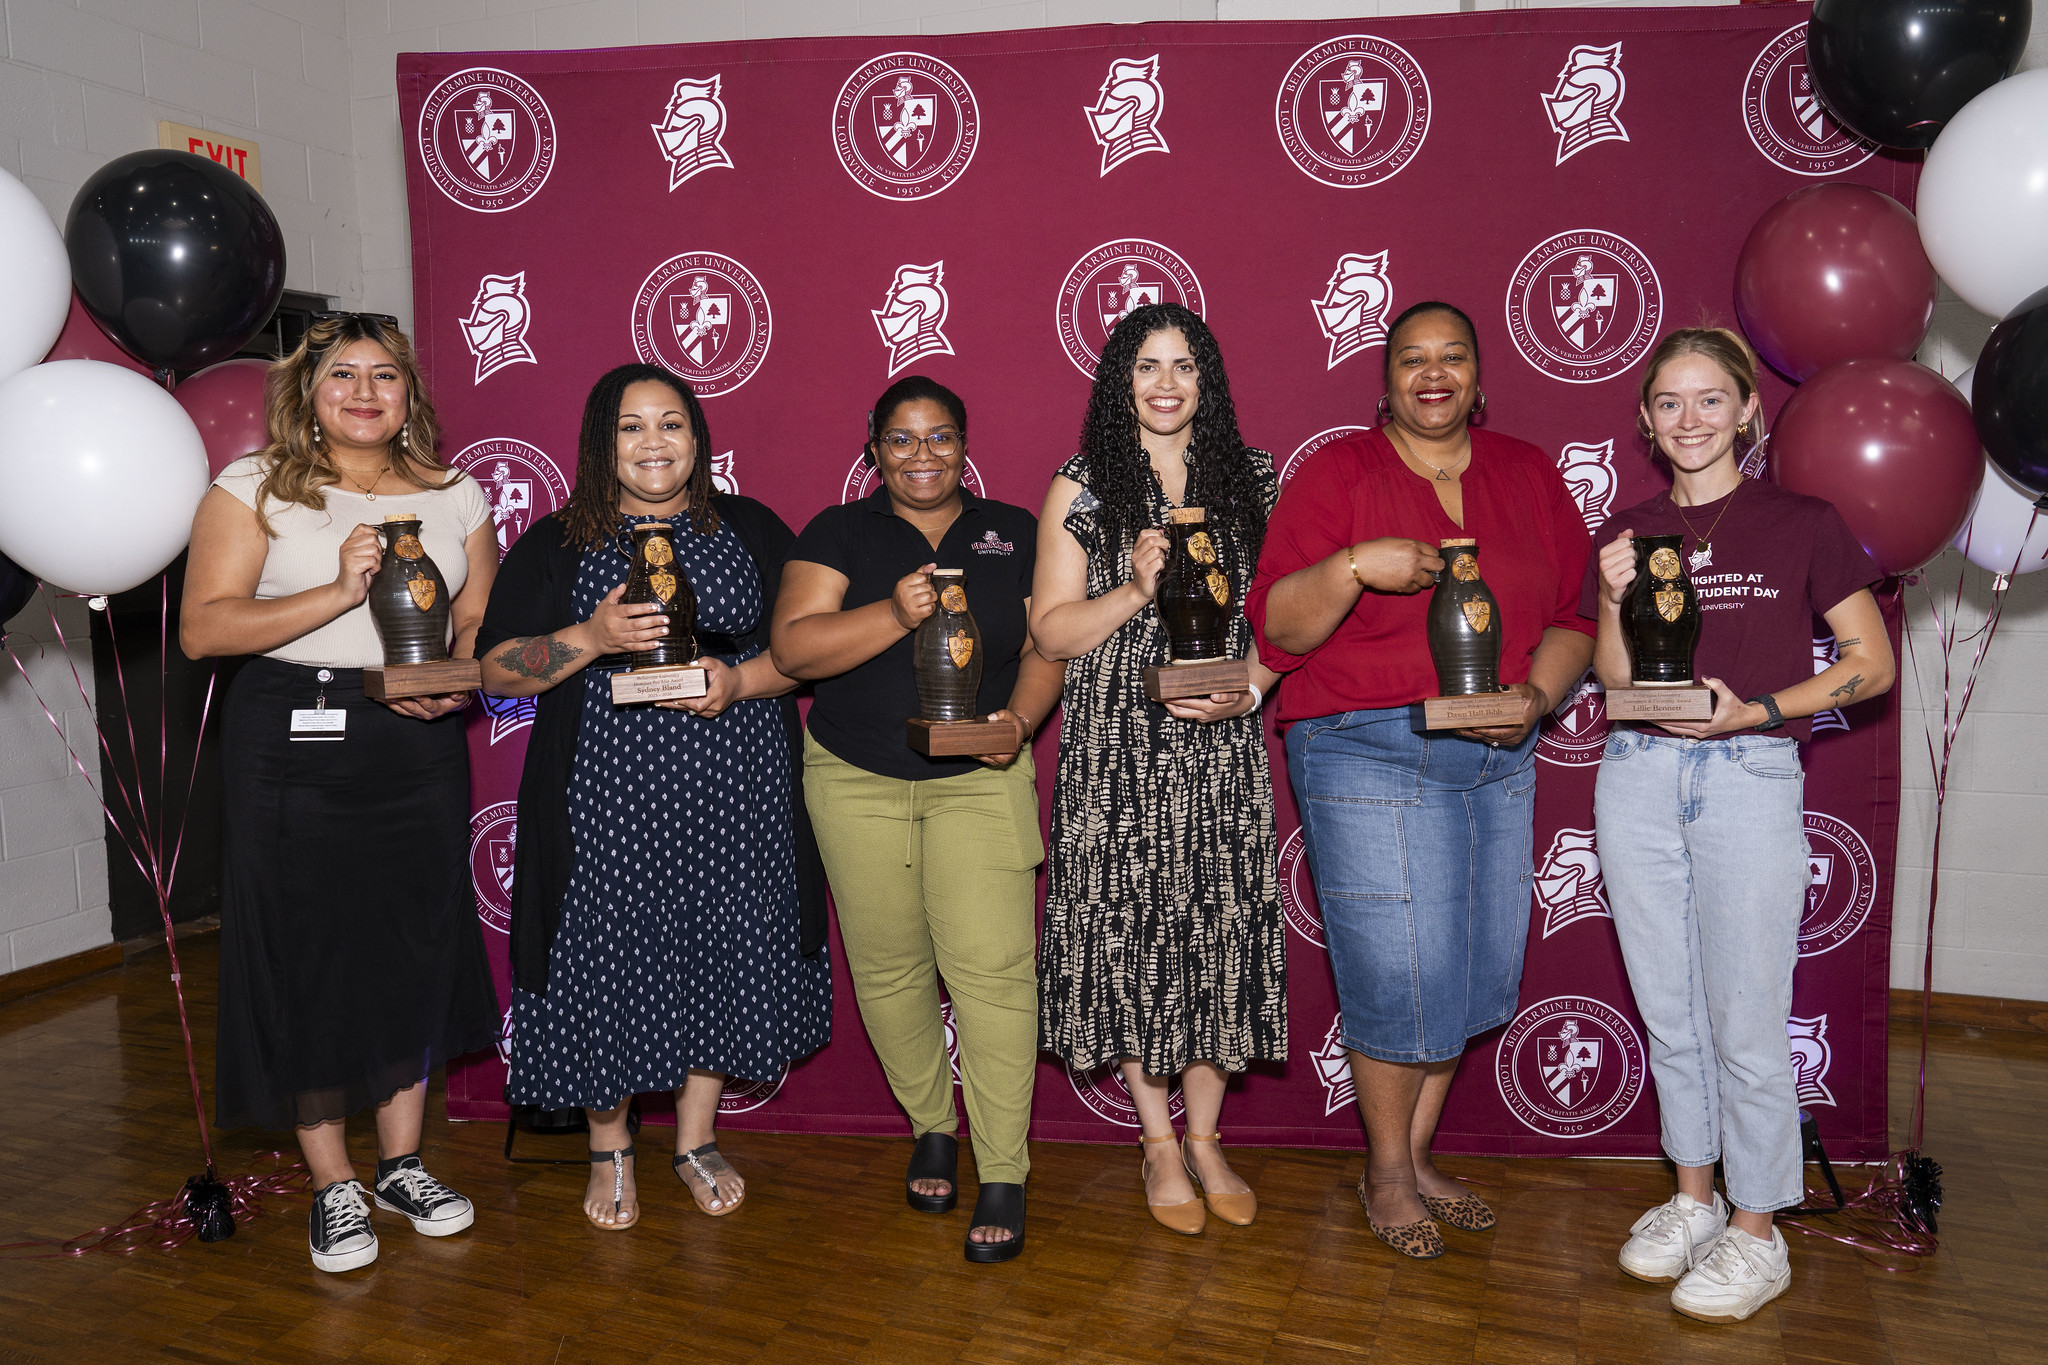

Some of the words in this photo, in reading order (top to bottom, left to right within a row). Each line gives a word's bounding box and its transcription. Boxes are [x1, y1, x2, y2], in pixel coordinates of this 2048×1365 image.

[1287, 41, 1355, 92] BELLARMINE
[1360, 41, 1422, 88] UNIVERSITY
[1755, 30, 1806, 78] BELLARM
[426, 73, 483, 120] BELLARMINE
[487, 74, 546, 119] UNIVERSITY
[841, 58, 904, 108] BELLARMINE
[909, 58, 970, 104] UNIVERSITY
[1281, 110, 1320, 173] LOUISVILLE
[1342, 174, 1366, 183] 1950
[1388, 106, 1425, 168] KENTUCKY
[1329, 155, 1361, 164] VERITATIS
[1363, 150, 1384, 162] AMORE
[1748, 97, 1786, 161] LOUISVILLE
[1809, 161, 1835, 170] 1950
[1798, 142, 1830, 151] VERITATIS
[423, 137, 462, 198] LOUISVILLE
[481, 199, 503, 208] 1950
[522, 136, 551, 194] KENTUCKY
[837, 126, 876, 186] LOUISVILLE
[897, 187, 920, 196] 1950
[941, 121, 974, 181] KENTUCKY
[885, 169, 915, 177] VERITATIS
[917, 163, 936, 176] AMORE
[462, 176, 468, 184] IN
[469, 181, 497, 190] VERITATIS
[500, 176, 517, 189] AMORE
[640, 257, 700, 306] BELLARMINE
[704, 258, 762, 304] UNIVERSITY
[1066, 245, 1130, 295] BELLARMINE
[1136, 245, 1196, 293] UNIVERSITY
[1516, 235, 1585, 287] BELLARMINE
[1591, 236, 1653, 285] UNIVERSITY
[636, 324, 656, 366] LOUISV
[694, 384, 715, 393] 1950
[735, 321, 767, 379] KENTUCKY
[1511, 305, 1550, 368] LOUISVILLE
[1572, 369, 1597, 378] 1950
[1620, 303, 1657, 364] KENTUCKY
[1561, 351, 1592, 359] VERITATIS
[1594, 345, 1615, 358] AMORE
[682, 367, 710, 375] VERITATIS
[712, 362, 731, 374] AMORE
[454, 443, 502, 471] LARMINE
[506, 444, 562, 490] UNIVERSITY
[1691, 574, 1743, 585] IGHTED
[1747, 574, 1763, 583] AT
[1697, 587, 1750, 598] TUDENT
[1754, 587, 1779, 598] DAY
[1702, 603, 1744, 611] UNIVERSITY
[1553, 735, 1584, 743] VERITATIS
[1565, 753, 1590, 762] 1950
[471, 806, 517, 838] LLARMINE
[1808, 817, 1869, 866] UNIVERSITY
[1280, 878, 1318, 937] LOUISVILLE
[1806, 922, 1827, 933] AMORE
[1832, 882, 1870, 940] KENTUCKY
[1506, 1001, 1571, 1048] BELLARMINE
[1576, 1002, 1636, 1049] UNIVERSITY
[720, 1101, 737, 1109] 950
[1127, 1115, 1137, 1123] 19
[1501, 1064, 1538, 1124] LOUISVILLE
[1559, 1125, 1582, 1134] 1950
[1605, 1065, 1640, 1120] KENTUCKY
[1548, 1107, 1578, 1116] VERITATIS
[1580, 1103, 1600, 1115] AMORE
